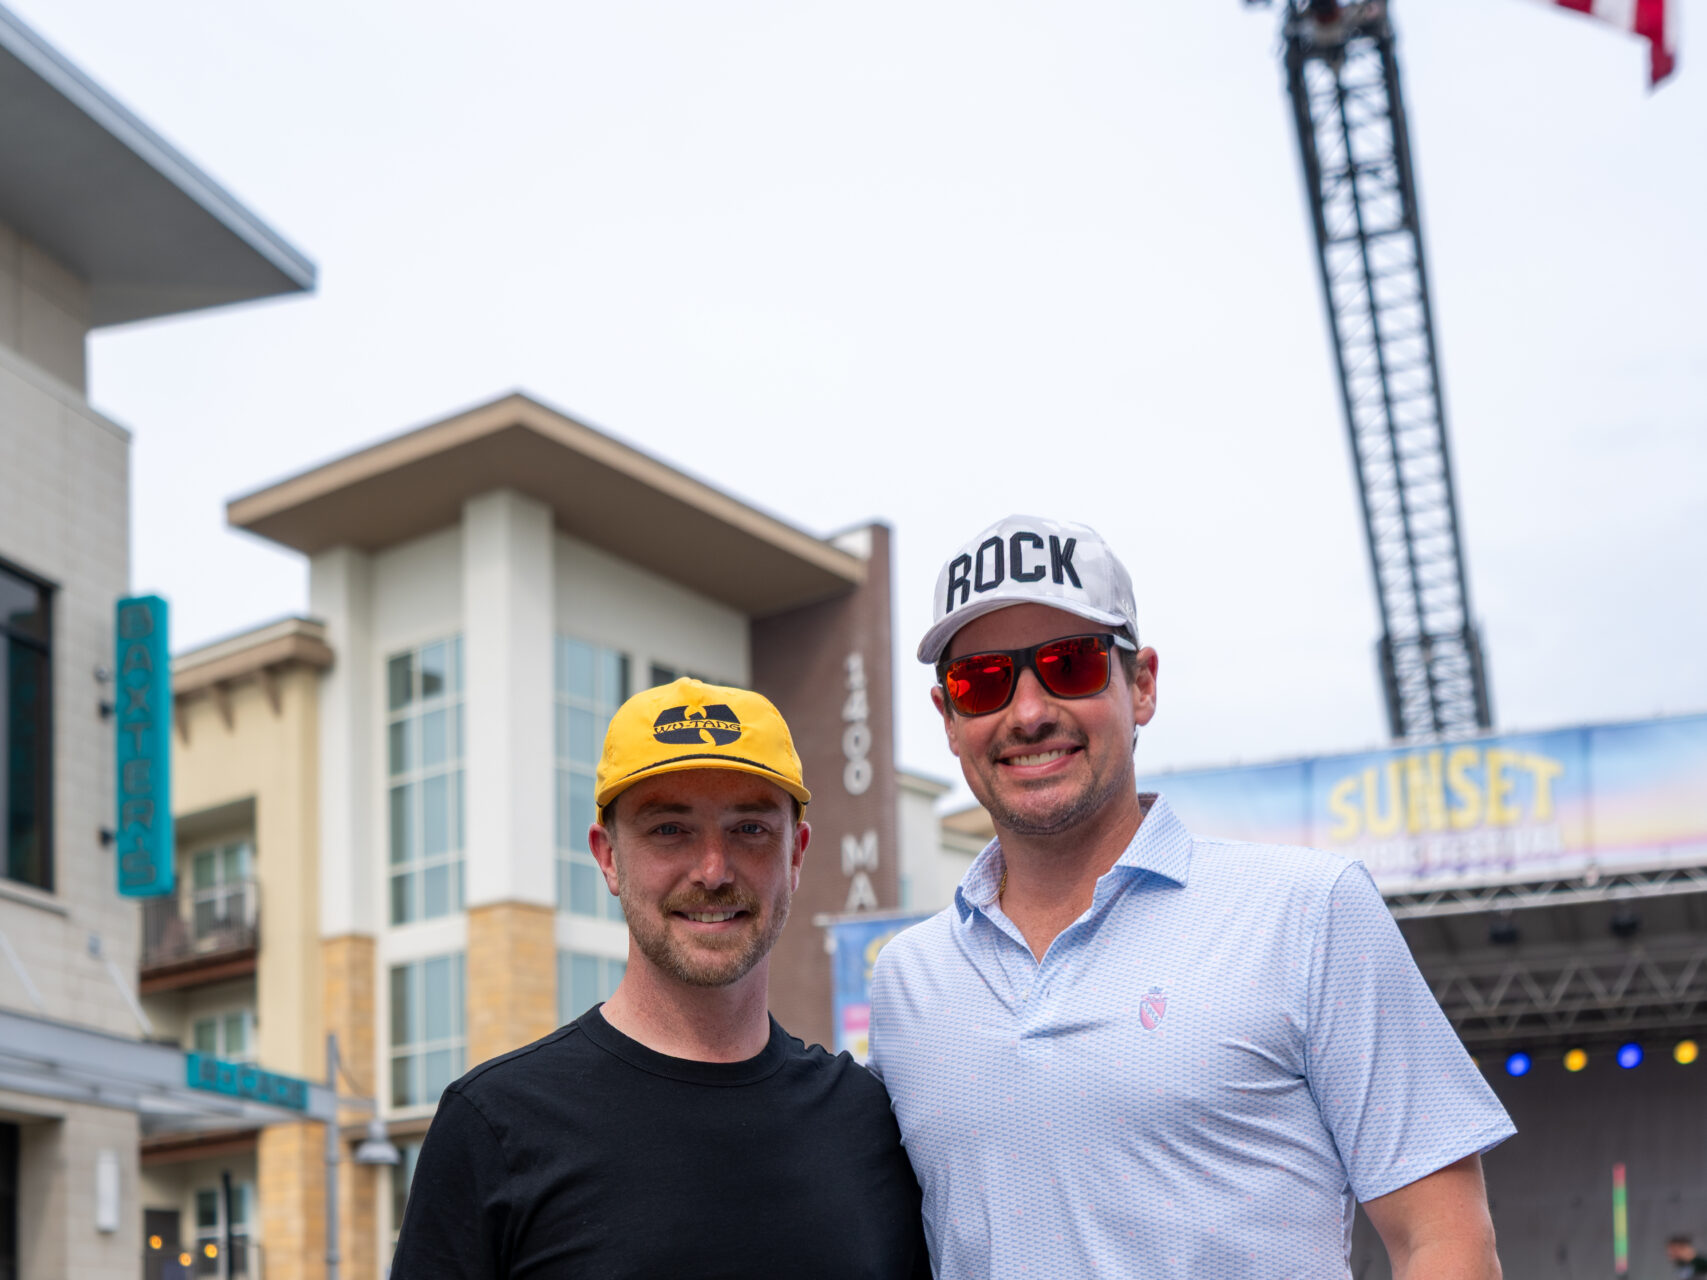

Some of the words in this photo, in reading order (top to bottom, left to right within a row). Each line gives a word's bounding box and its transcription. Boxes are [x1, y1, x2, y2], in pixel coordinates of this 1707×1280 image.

[946, 531, 1083, 615] ROCK
[119, 603, 156, 888] BAXTER'S
[654, 719, 741, 735] WU-TANG
[842, 651, 874, 796] 1400
[1328, 744, 1564, 842] SUNSET
